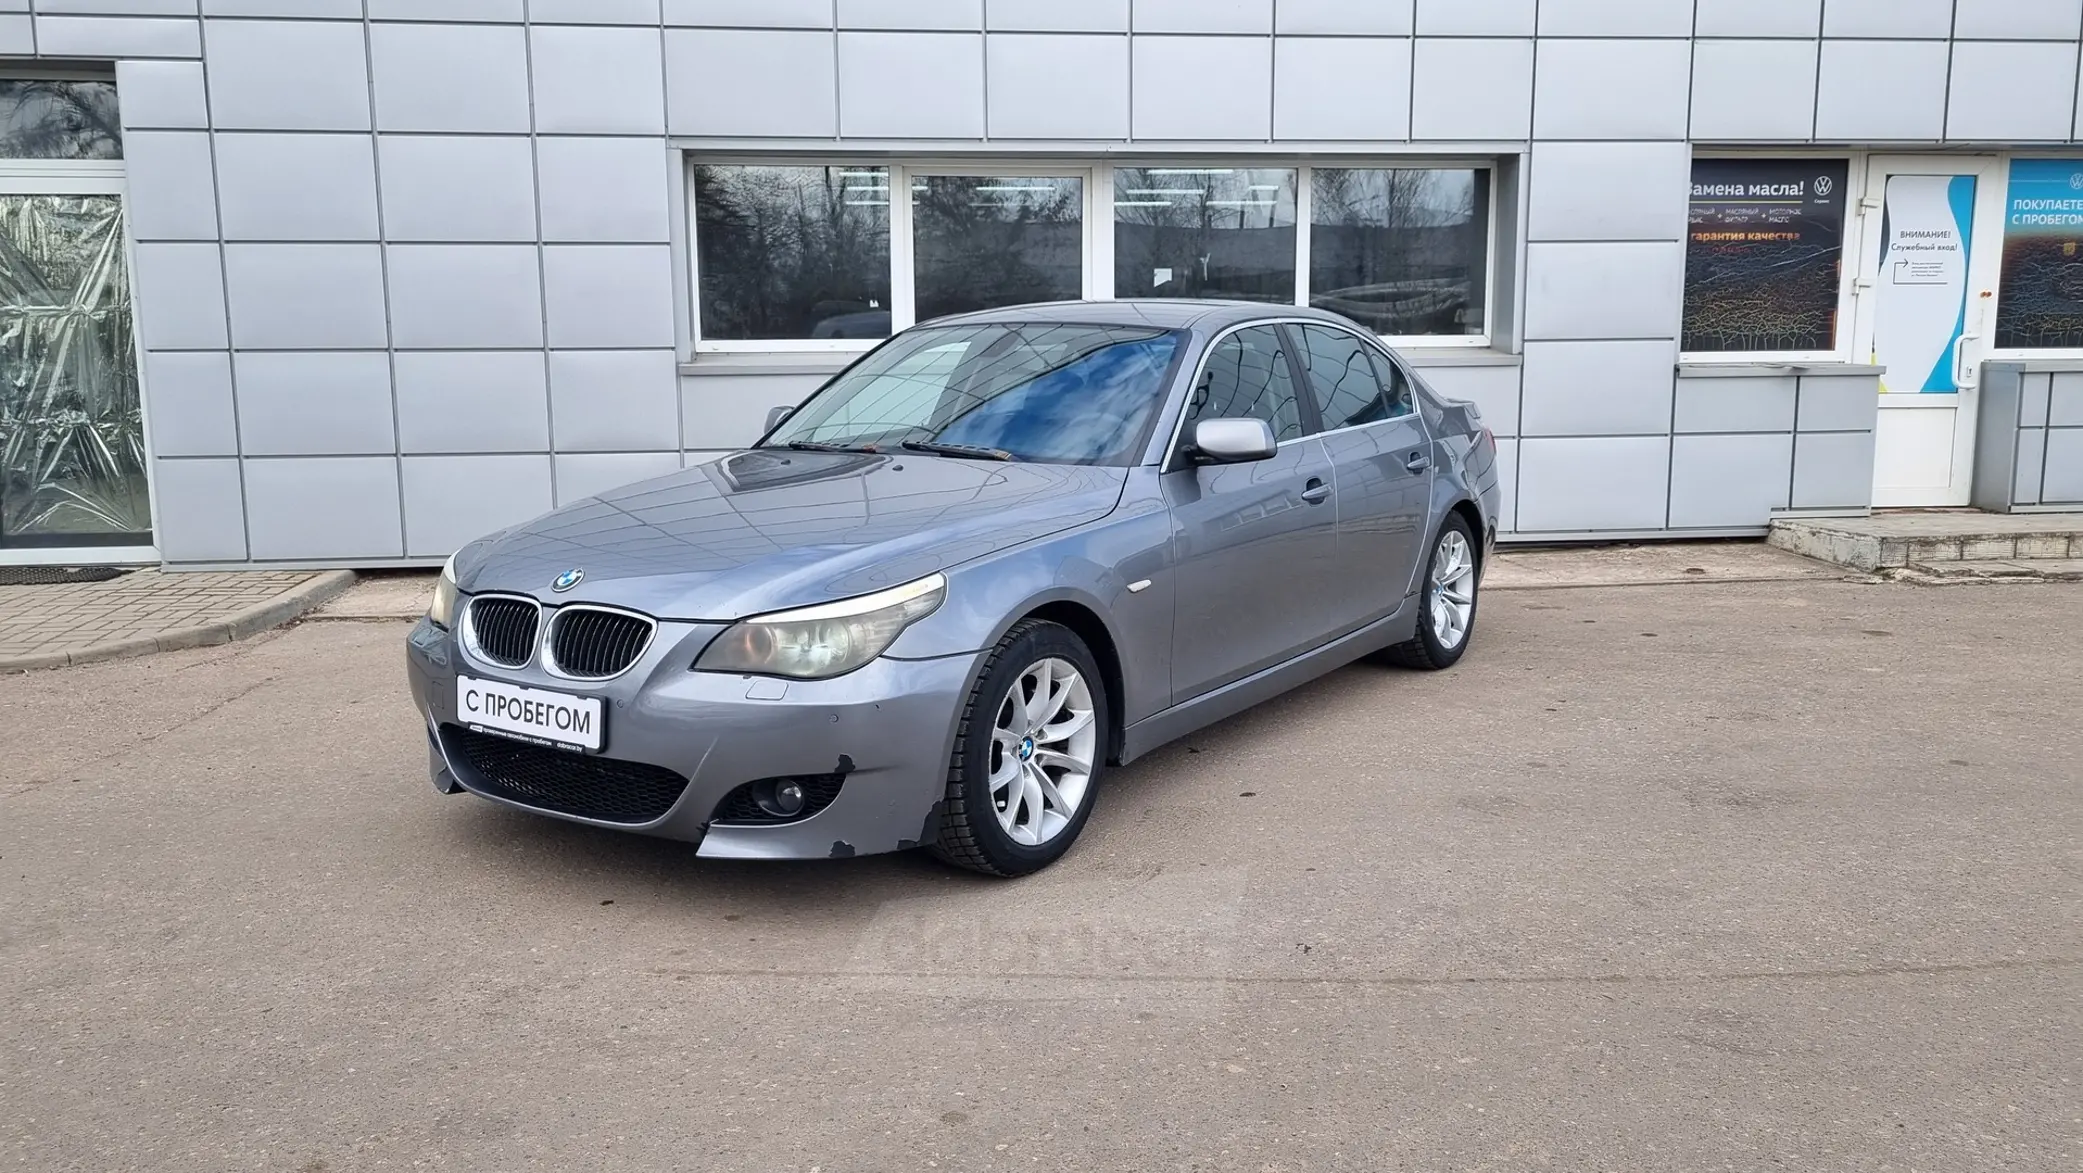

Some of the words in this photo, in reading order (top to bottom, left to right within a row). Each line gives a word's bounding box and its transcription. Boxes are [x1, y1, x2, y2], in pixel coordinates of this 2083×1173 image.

[1748, 180, 1804, 196] масла!
[2013, 199, 2083, 210] ПОКУПАЕТЕ
[2012, 214, 2019, 225] С
[1691, 231, 1745, 242] гарантия
[1747, 231, 1800, 241] качества
[1900, 230, 1951, 239] ВНИМАНИЕ!
[1891, 242, 1935, 252] Служебный
[1937, 243, 1958, 252] вход!
[466, 689, 479, 712] С
[485, 692, 590, 735] ПРОБЕГОМ
